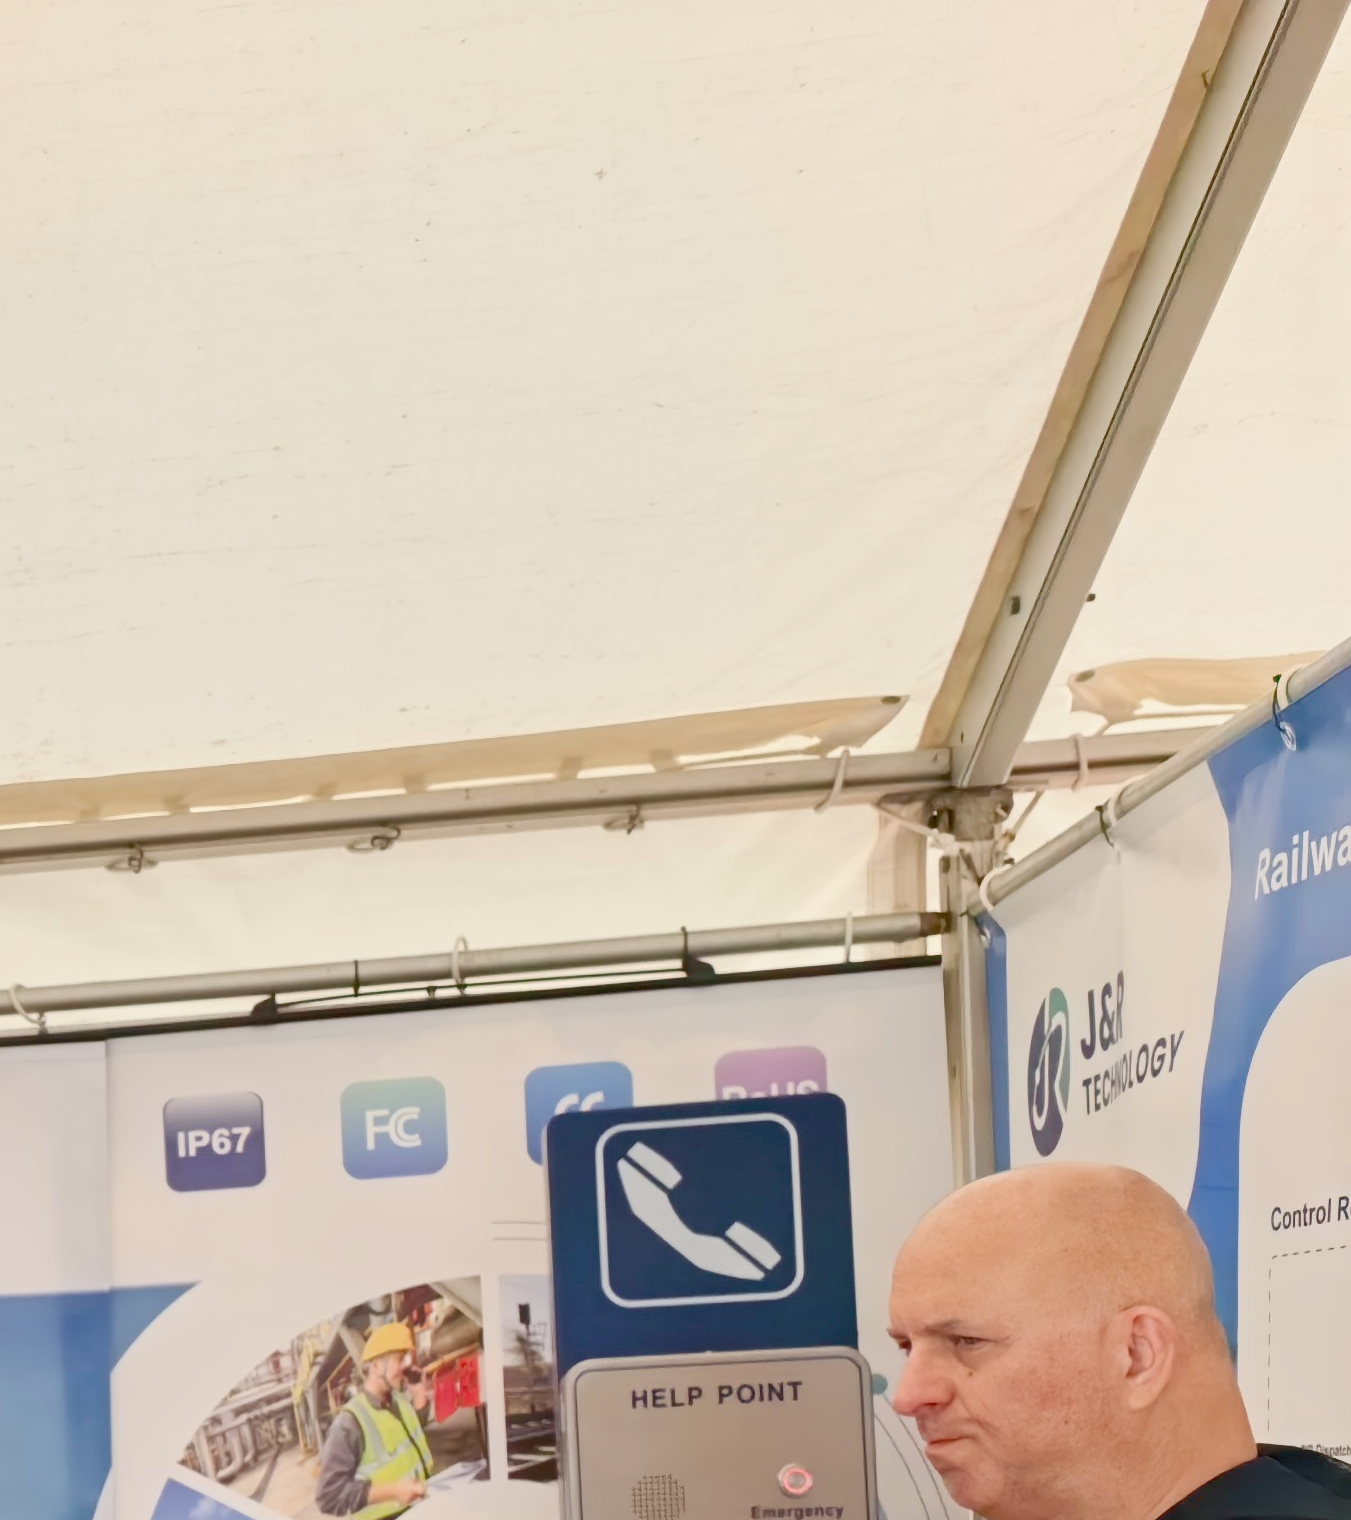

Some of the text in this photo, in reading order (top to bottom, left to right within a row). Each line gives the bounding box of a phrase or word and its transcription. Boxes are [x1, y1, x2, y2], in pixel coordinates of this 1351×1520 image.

[1081, 970, 1124, 1060] J&R
[1082, 1030, 1185, 1116] TECHNOLOGY
[176, 1125, 251, 1160] IP67
[1270, 1196, 1351, 1232] Control R
[631, 1380, 803, 1409] HELP POINT
[750, 1505, 844, 1520] Emergency
